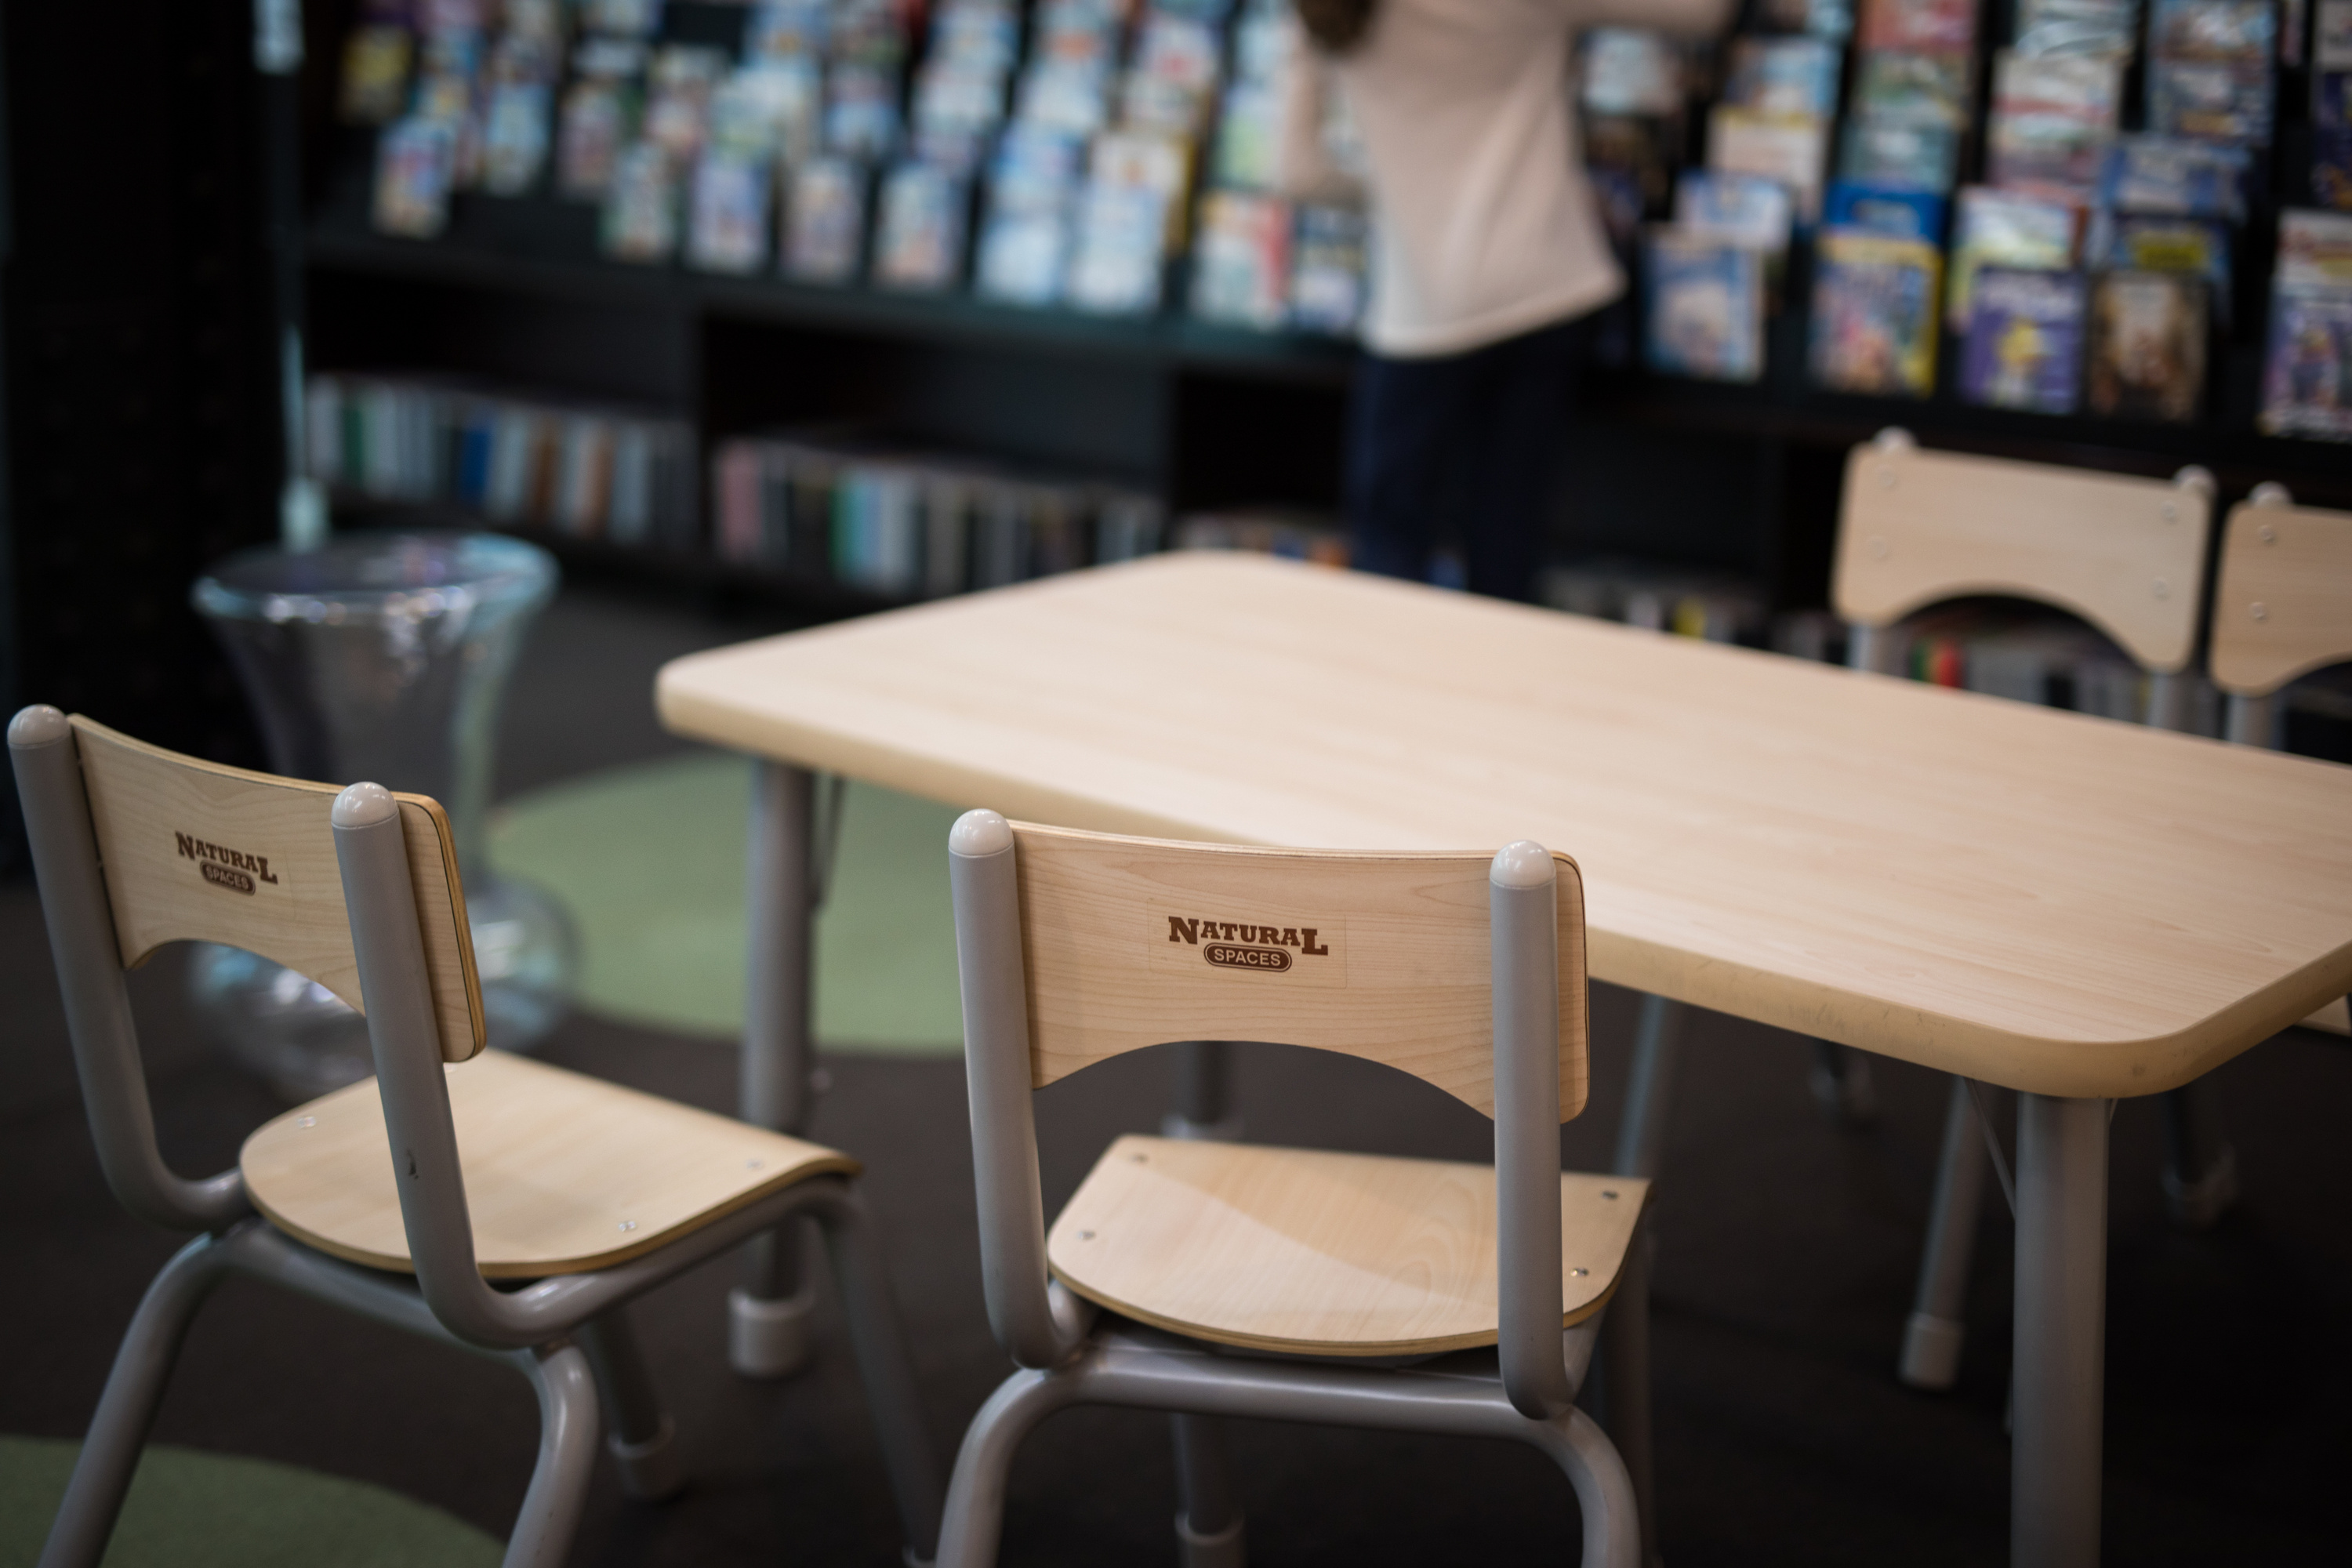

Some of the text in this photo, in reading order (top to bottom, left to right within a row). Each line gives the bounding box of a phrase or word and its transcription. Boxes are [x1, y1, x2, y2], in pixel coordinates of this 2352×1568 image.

[175, 830, 278, 884] NATURAL
[205, 865, 249, 890] SPACES
[1168, 916, 1329, 956] NATURAL
[1214, 948, 1282, 967] SPACES
